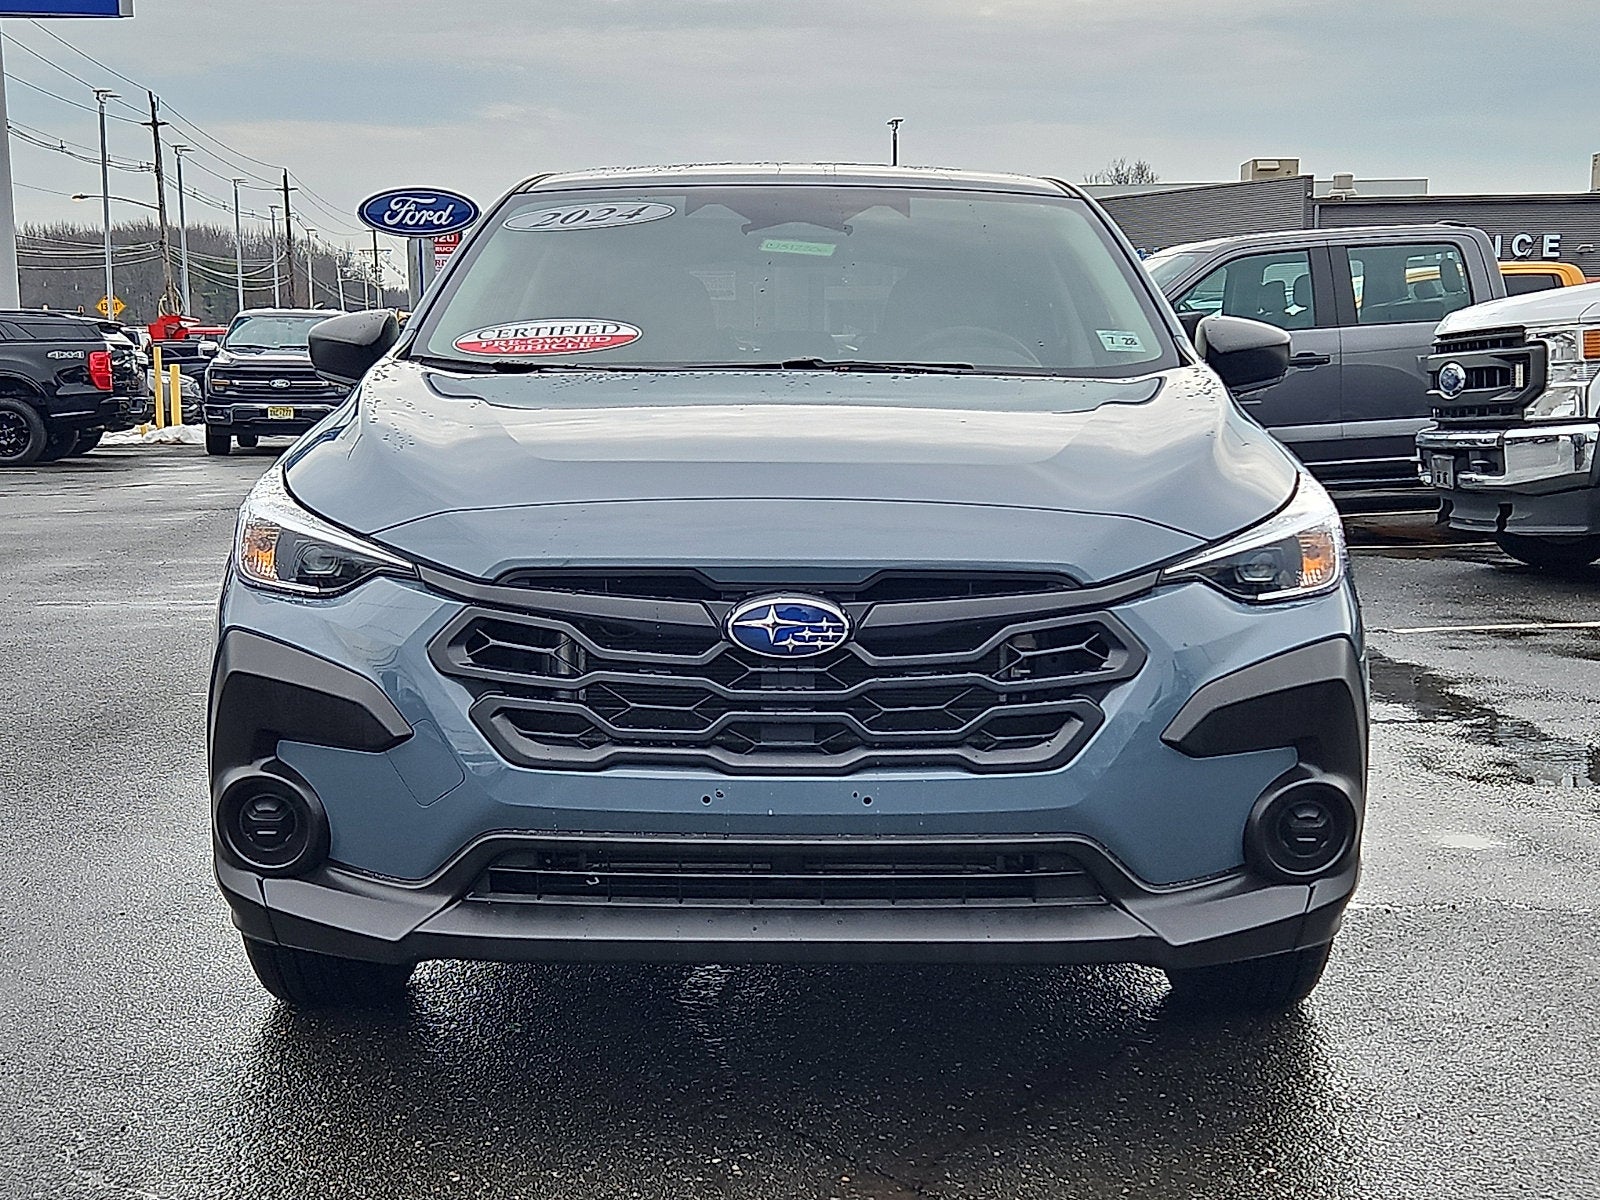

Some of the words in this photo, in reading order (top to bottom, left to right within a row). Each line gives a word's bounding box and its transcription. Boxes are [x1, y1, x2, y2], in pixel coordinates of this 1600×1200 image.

[384, 196, 455, 226] Ford
[530, 204, 651, 228] 2024
[476, 324, 621, 341] CERTIFIED
[480, 335, 613, 349] PRE-OWNED
[498, 341, 592, 353] VEHICLE
[1106, 336, 1115, 345] 7
